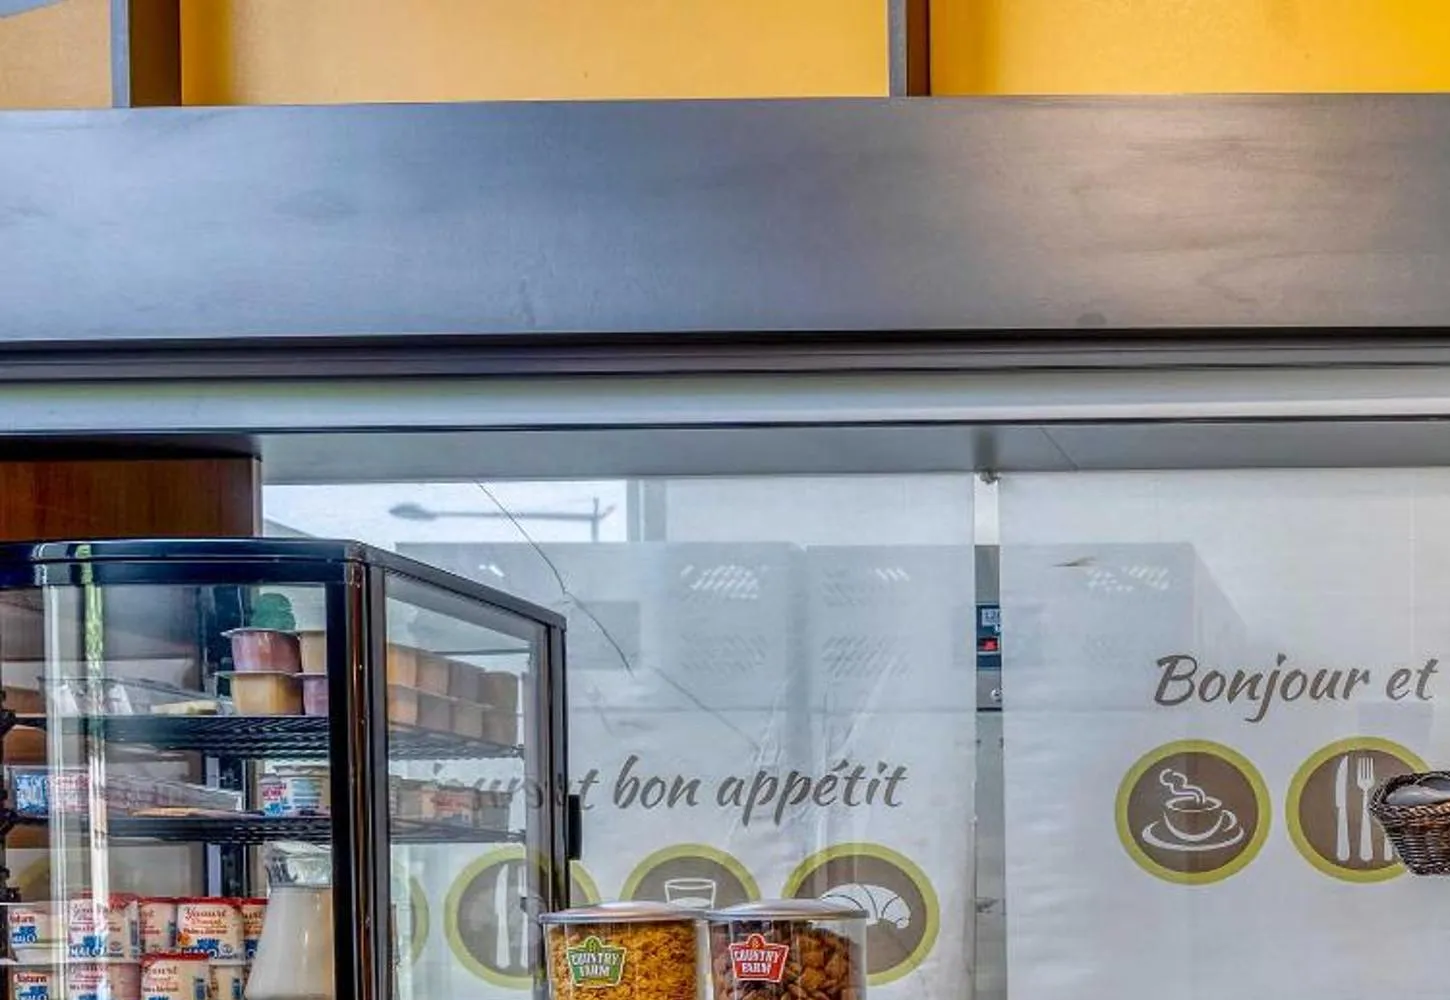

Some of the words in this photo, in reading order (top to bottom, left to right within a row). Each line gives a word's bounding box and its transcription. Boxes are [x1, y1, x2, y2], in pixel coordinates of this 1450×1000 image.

[1154, 653, 1370, 722] Bonjour
[1386, 658, 1439, 701] et
[613, 754, 701, 809] bon
[716, 759, 907, 826] appétit
[571, 952, 620, 965] COUNTRY
[734, 949, 780, 963] COUNTRY
